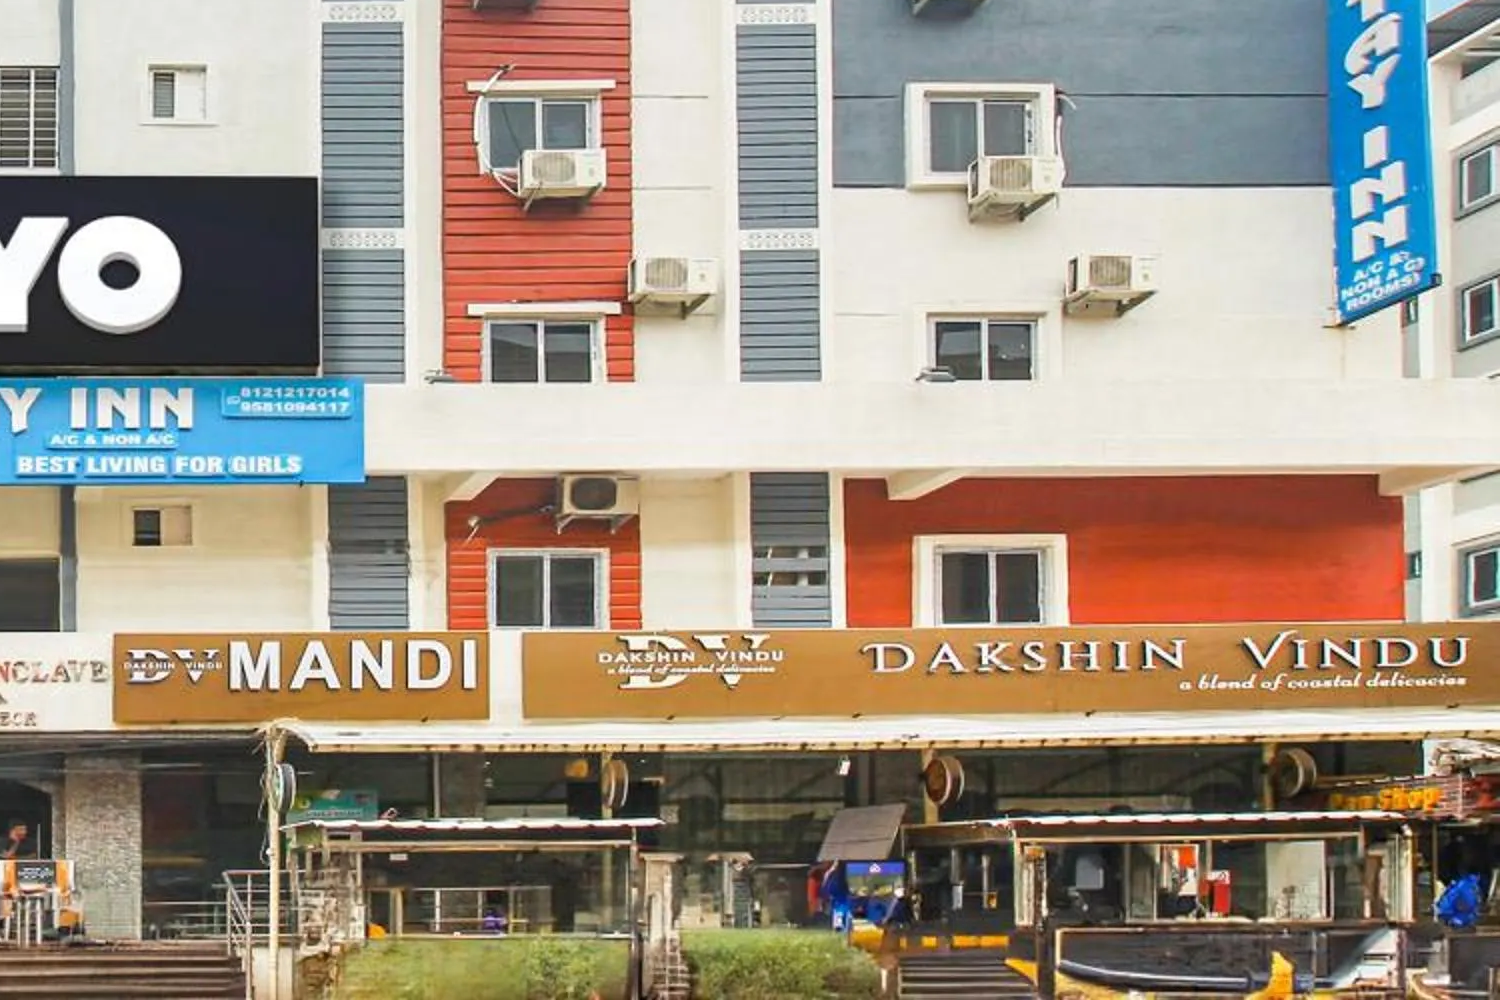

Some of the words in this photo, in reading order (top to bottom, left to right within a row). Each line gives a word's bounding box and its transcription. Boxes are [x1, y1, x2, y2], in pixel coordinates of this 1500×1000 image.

[1350, 125, 1408, 263] INN
[70, 387, 195, 430] INN
[51, 434, 79, 446] A/C
[83, 434, 97, 446] &
[102, 434, 145, 446] NON
[149, 434, 176, 446] A/C
[17, 456, 79, 474] BEST
[86, 456, 167, 474] LIVING
[174, 456, 225, 474] FOR
[230, 455, 301, 474] GIRLS
[229, 639, 478, 691] MANDI
[598, 651, 696, 664] DAKSHIN
[715, 650, 785, 662] VINDU
[860, 637, 1188, 675] DAKSHIN
[1242, 629, 1471, 670] VINDU
[1179, 680, 1192, 692] a
[1197, 674, 1255, 690] blend
[1260, 673, 1287, 691] of
[1287, 672, 1363, 689] coastal
[1366, 671, 1468, 688] delicacies
